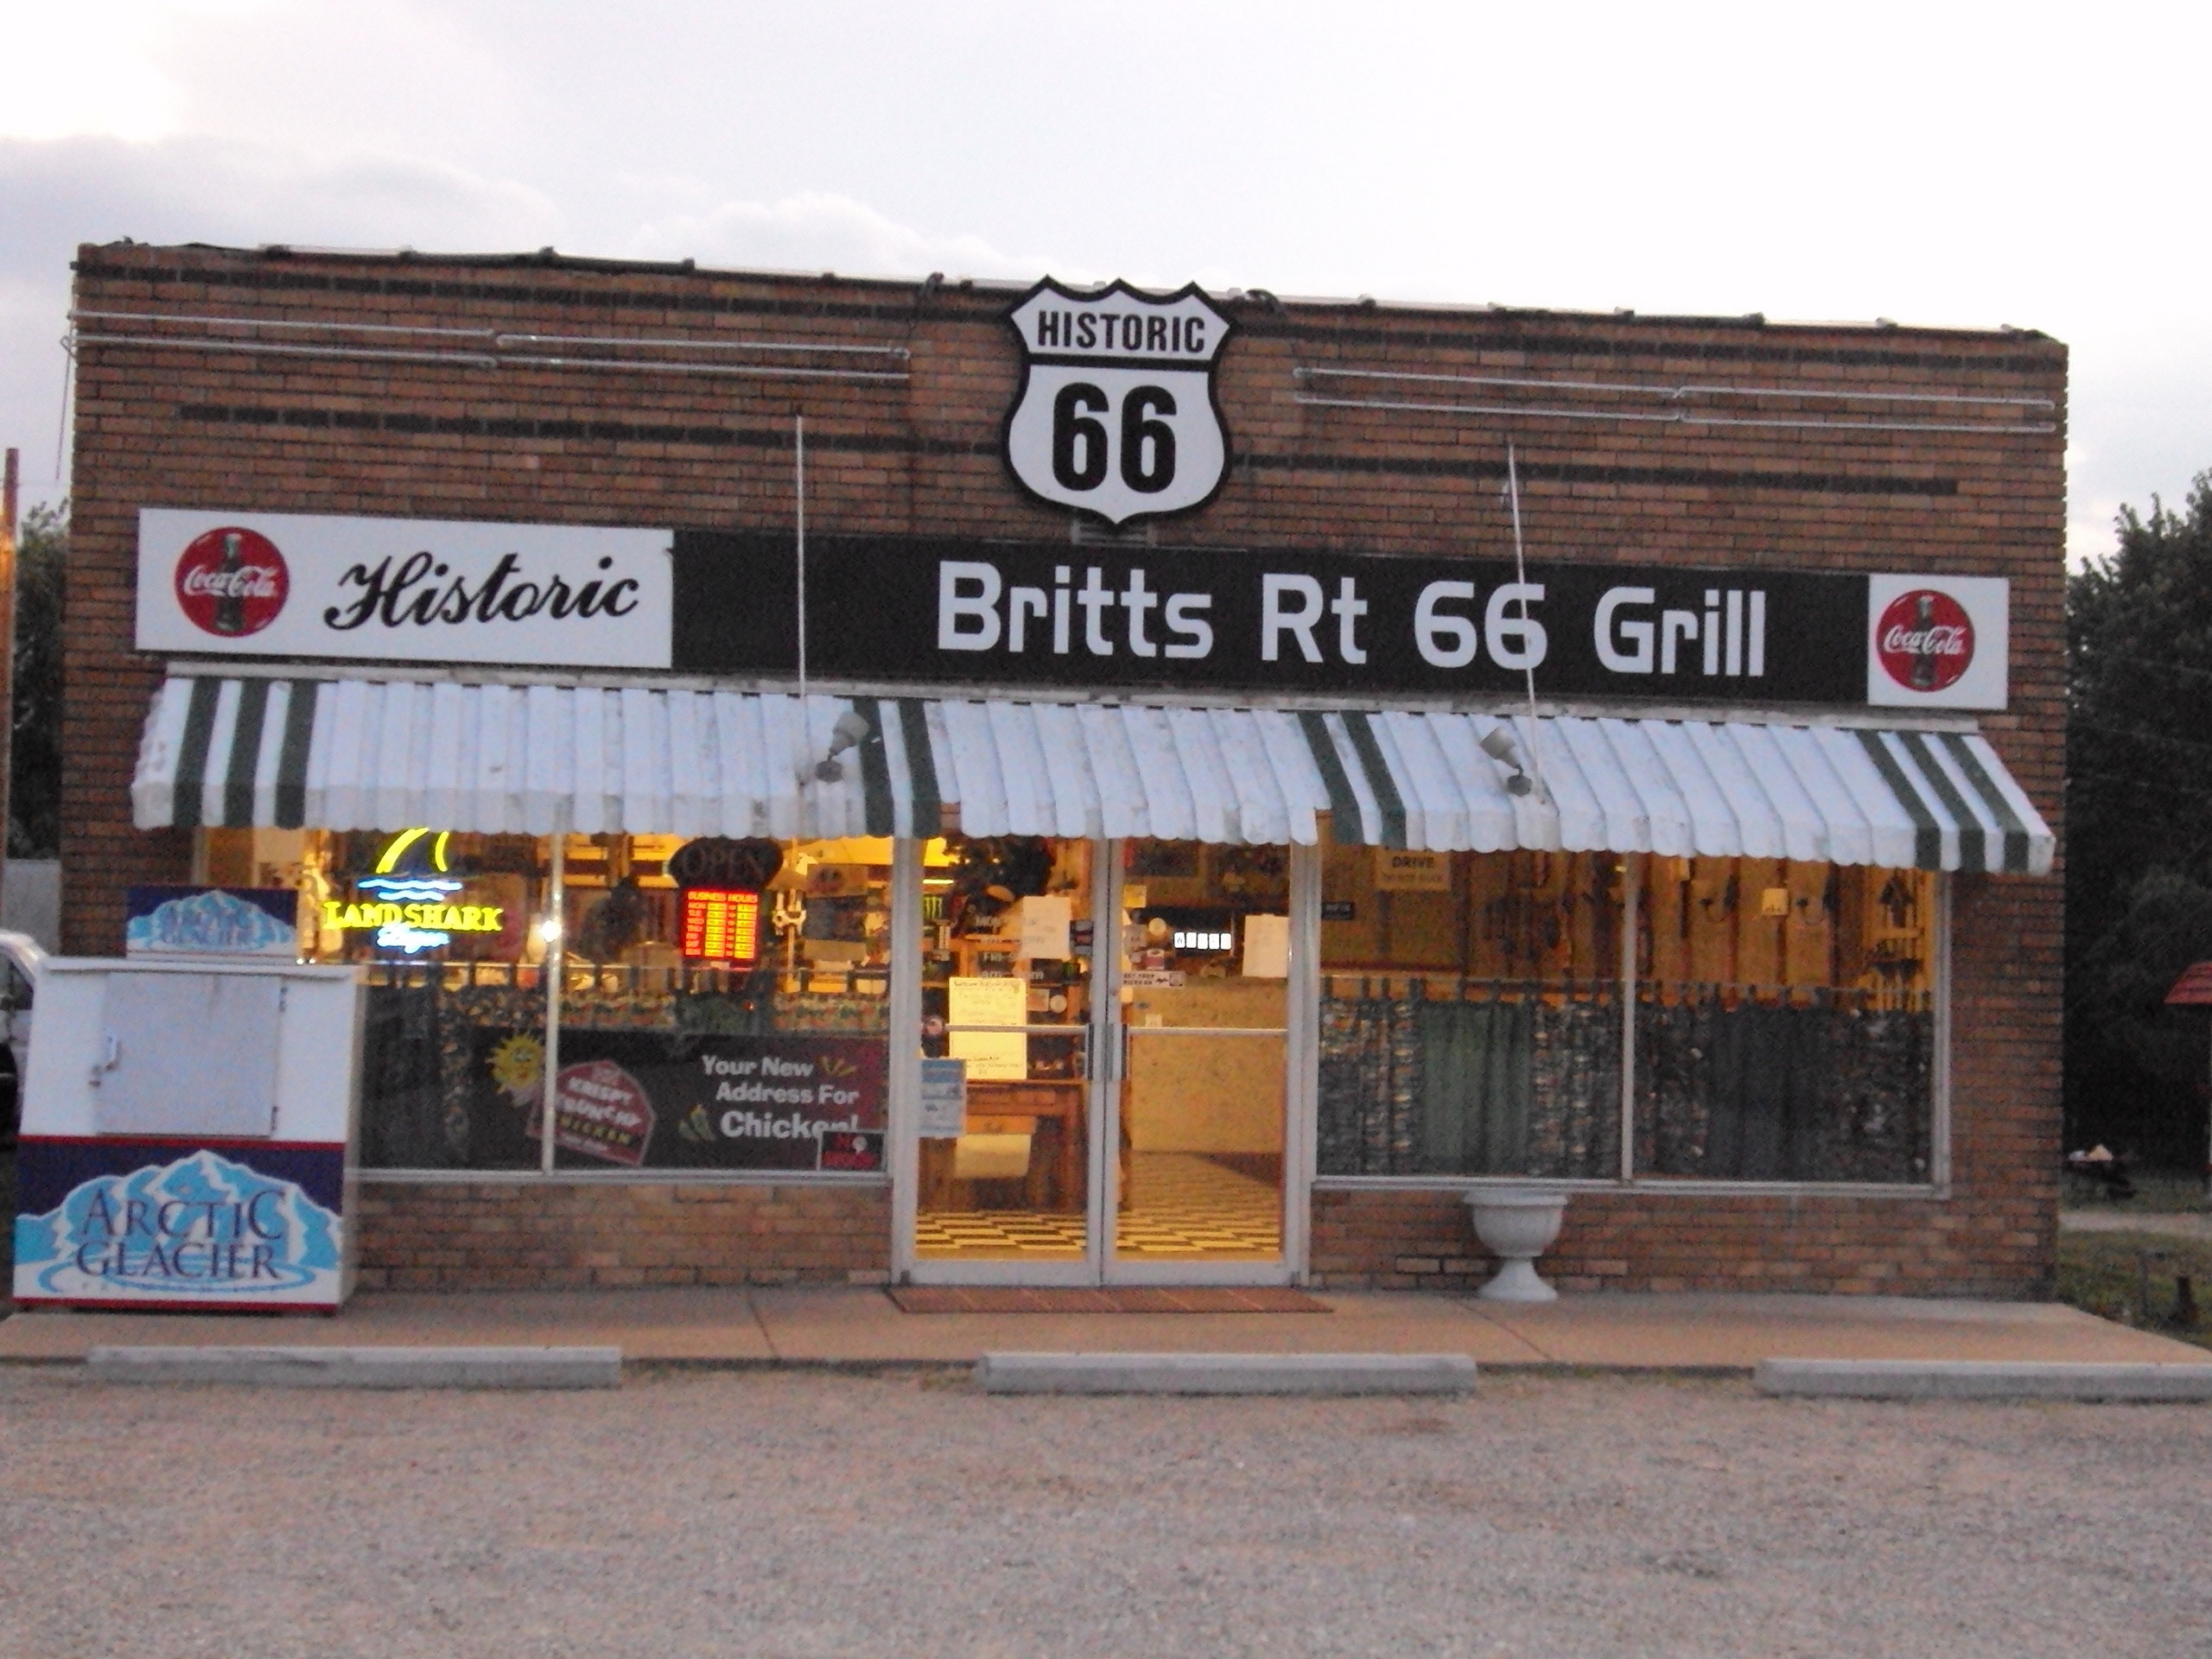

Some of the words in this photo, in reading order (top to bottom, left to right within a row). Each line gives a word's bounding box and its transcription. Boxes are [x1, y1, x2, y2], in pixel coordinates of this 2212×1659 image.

[1038, 311, 1205, 353] HISTORIC
[1052, 382, 1177, 493] 66
[323, 550, 639, 631] Historic
[938, 560, 1214, 659] Britts
[1262, 572, 1368, 664] Rt
[1414, 580, 1548, 671] 66
[1593, 586, 1766, 677] Grill
[702, 1054, 757, 1076] Your
[761, 1056, 814, 1077] New
[715, 1081, 814, 1104] Address
[817, 1084, 861, 1105] For
[81, 1187, 287, 1241] ARCTIC
[75, 1241, 282, 1280] GLACIER
